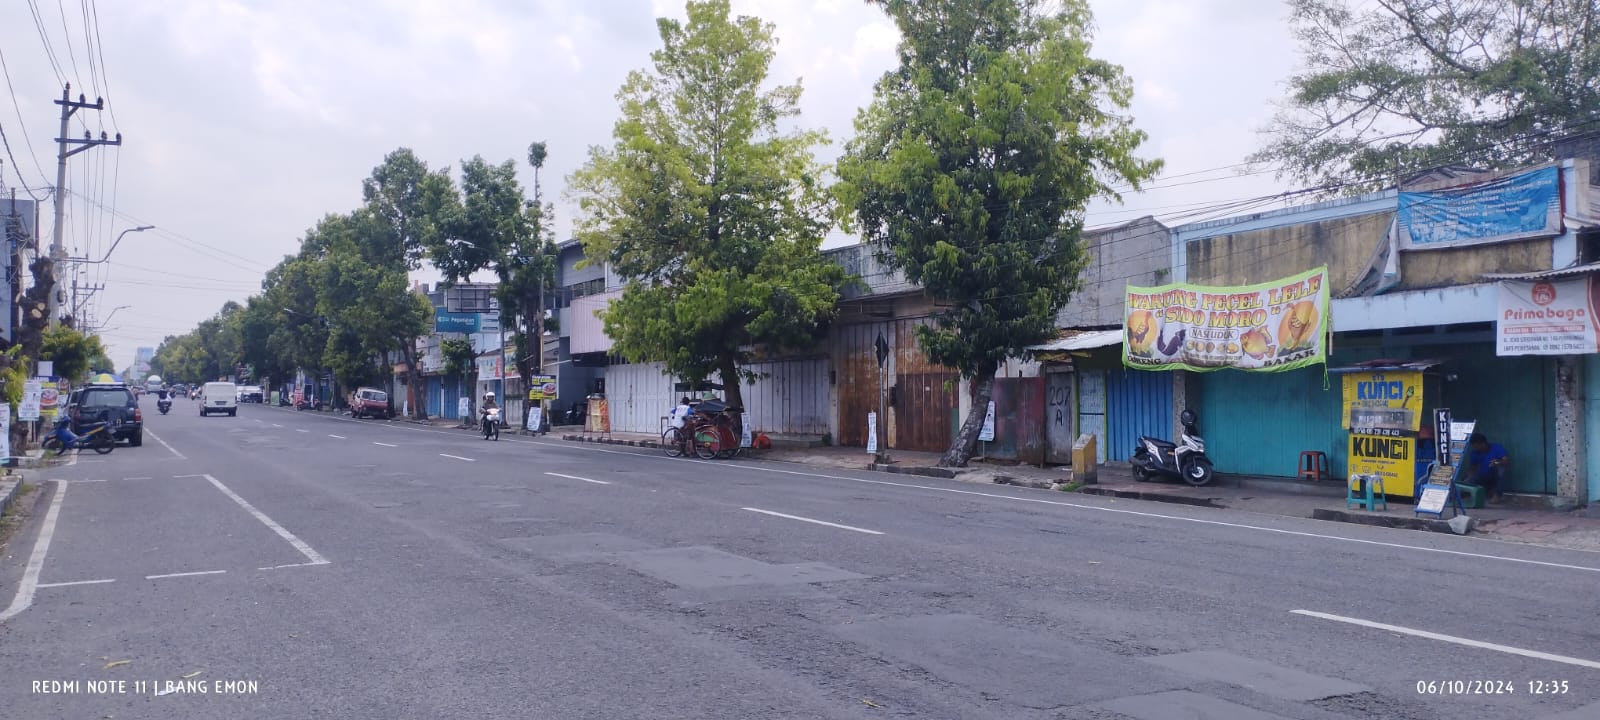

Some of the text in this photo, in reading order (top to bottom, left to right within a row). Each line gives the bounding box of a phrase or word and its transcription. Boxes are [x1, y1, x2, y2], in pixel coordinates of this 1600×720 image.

[1128, 274, 1322, 312] WARUNG PECEL LELE
[1264, 349, 1316, 367] BAKAR
[1049, 386, 1071, 406] 207
[1055, 409, 1063, 426] A
[1439, 411, 1448, 464] KUNCI
[1353, 437, 1408, 460] KUNCI
